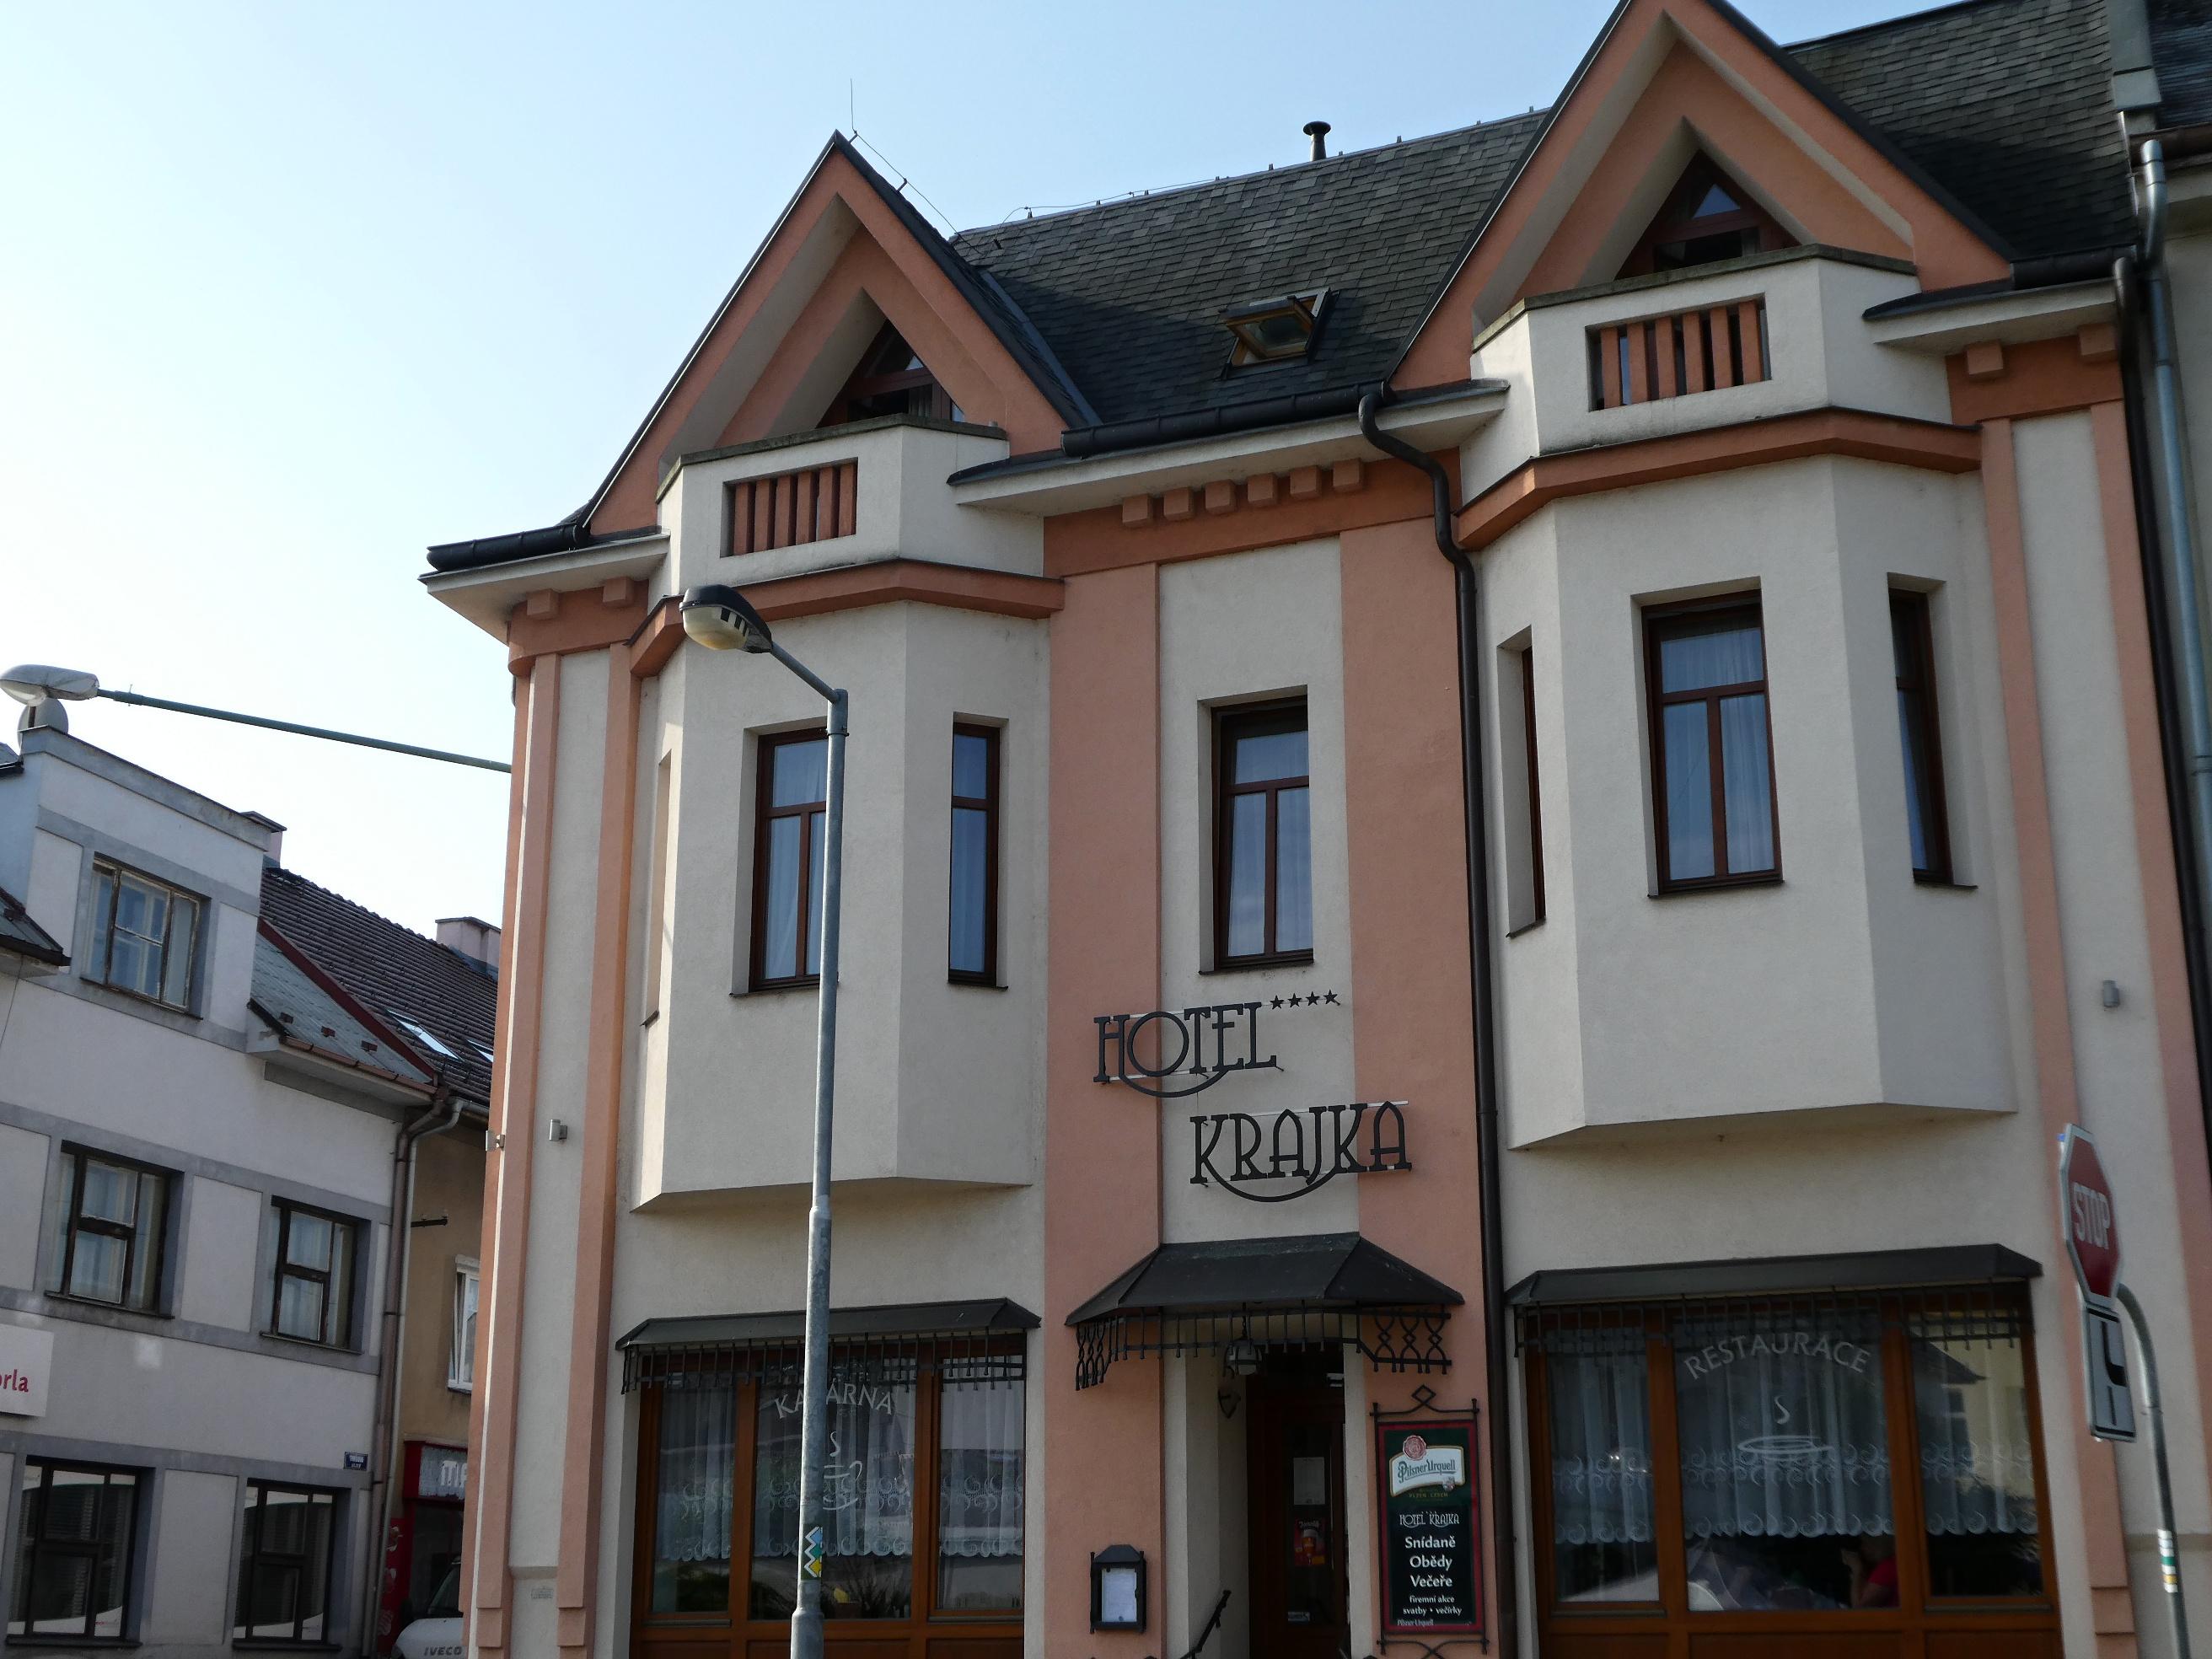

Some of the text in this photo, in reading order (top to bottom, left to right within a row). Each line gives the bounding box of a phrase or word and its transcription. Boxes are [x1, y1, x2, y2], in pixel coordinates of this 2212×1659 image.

[1093, 1001, 1277, 1098] HOTEL
[1189, 1101, 1412, 1203] KRAJKA
[2073, 1182, 2111, 1250] STOP
[1684, 1332, 1871, 1380] RESTAURACE
[0, 1368, 29, 1393] rla
[775, 1377, 892, 1419] KAÁRNA
[1397, 1459, 1456, 1484] Pilsner Urquell
[1399, 1513, 1459, 1528] HOTEL KRAJKA
[1404, 1534, 1456, 1549] Snídaně
[1409, 1554, 1452, 1571] Obědy
[1409, 1574, 1453, 1587] Večeře
[1409, 1594, 1455, 1603] firemní akce
[1403, 1606, 1427, 1616] svatby
[424, 1646, 462, 1656] IVECO
